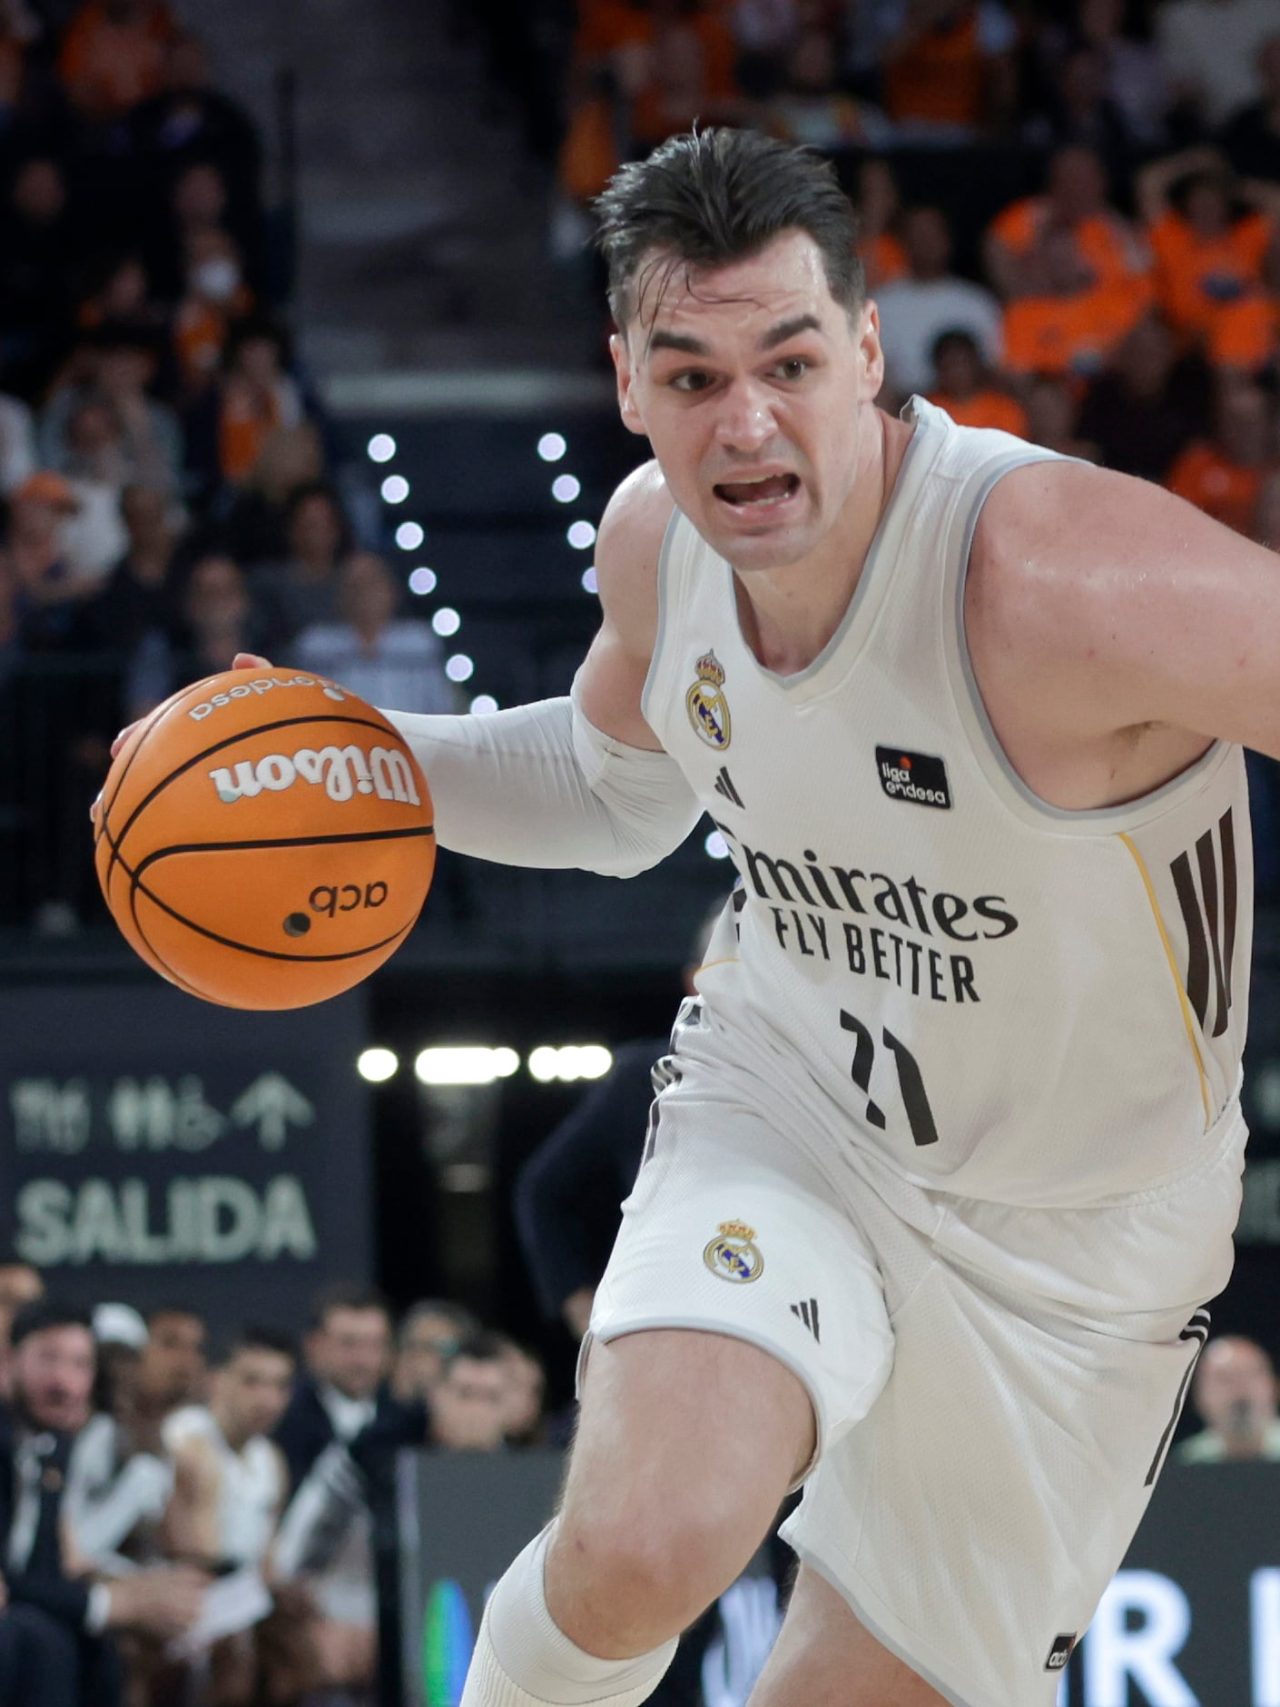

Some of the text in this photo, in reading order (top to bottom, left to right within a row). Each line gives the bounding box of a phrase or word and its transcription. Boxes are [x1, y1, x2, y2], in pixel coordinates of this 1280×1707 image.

[188, 675, 316, 721] endesa
[208, 745, 421, 805] Wilson
[881, 762, 911, 783] liga
[886, 781, 947, 805] endesa
[308, 880, 389, 918] acb
[768, 906, 831, 961] FLY
[842, 922, 982, 1004] BETTER
[16, 1175, 317, 1266] SALIDA
